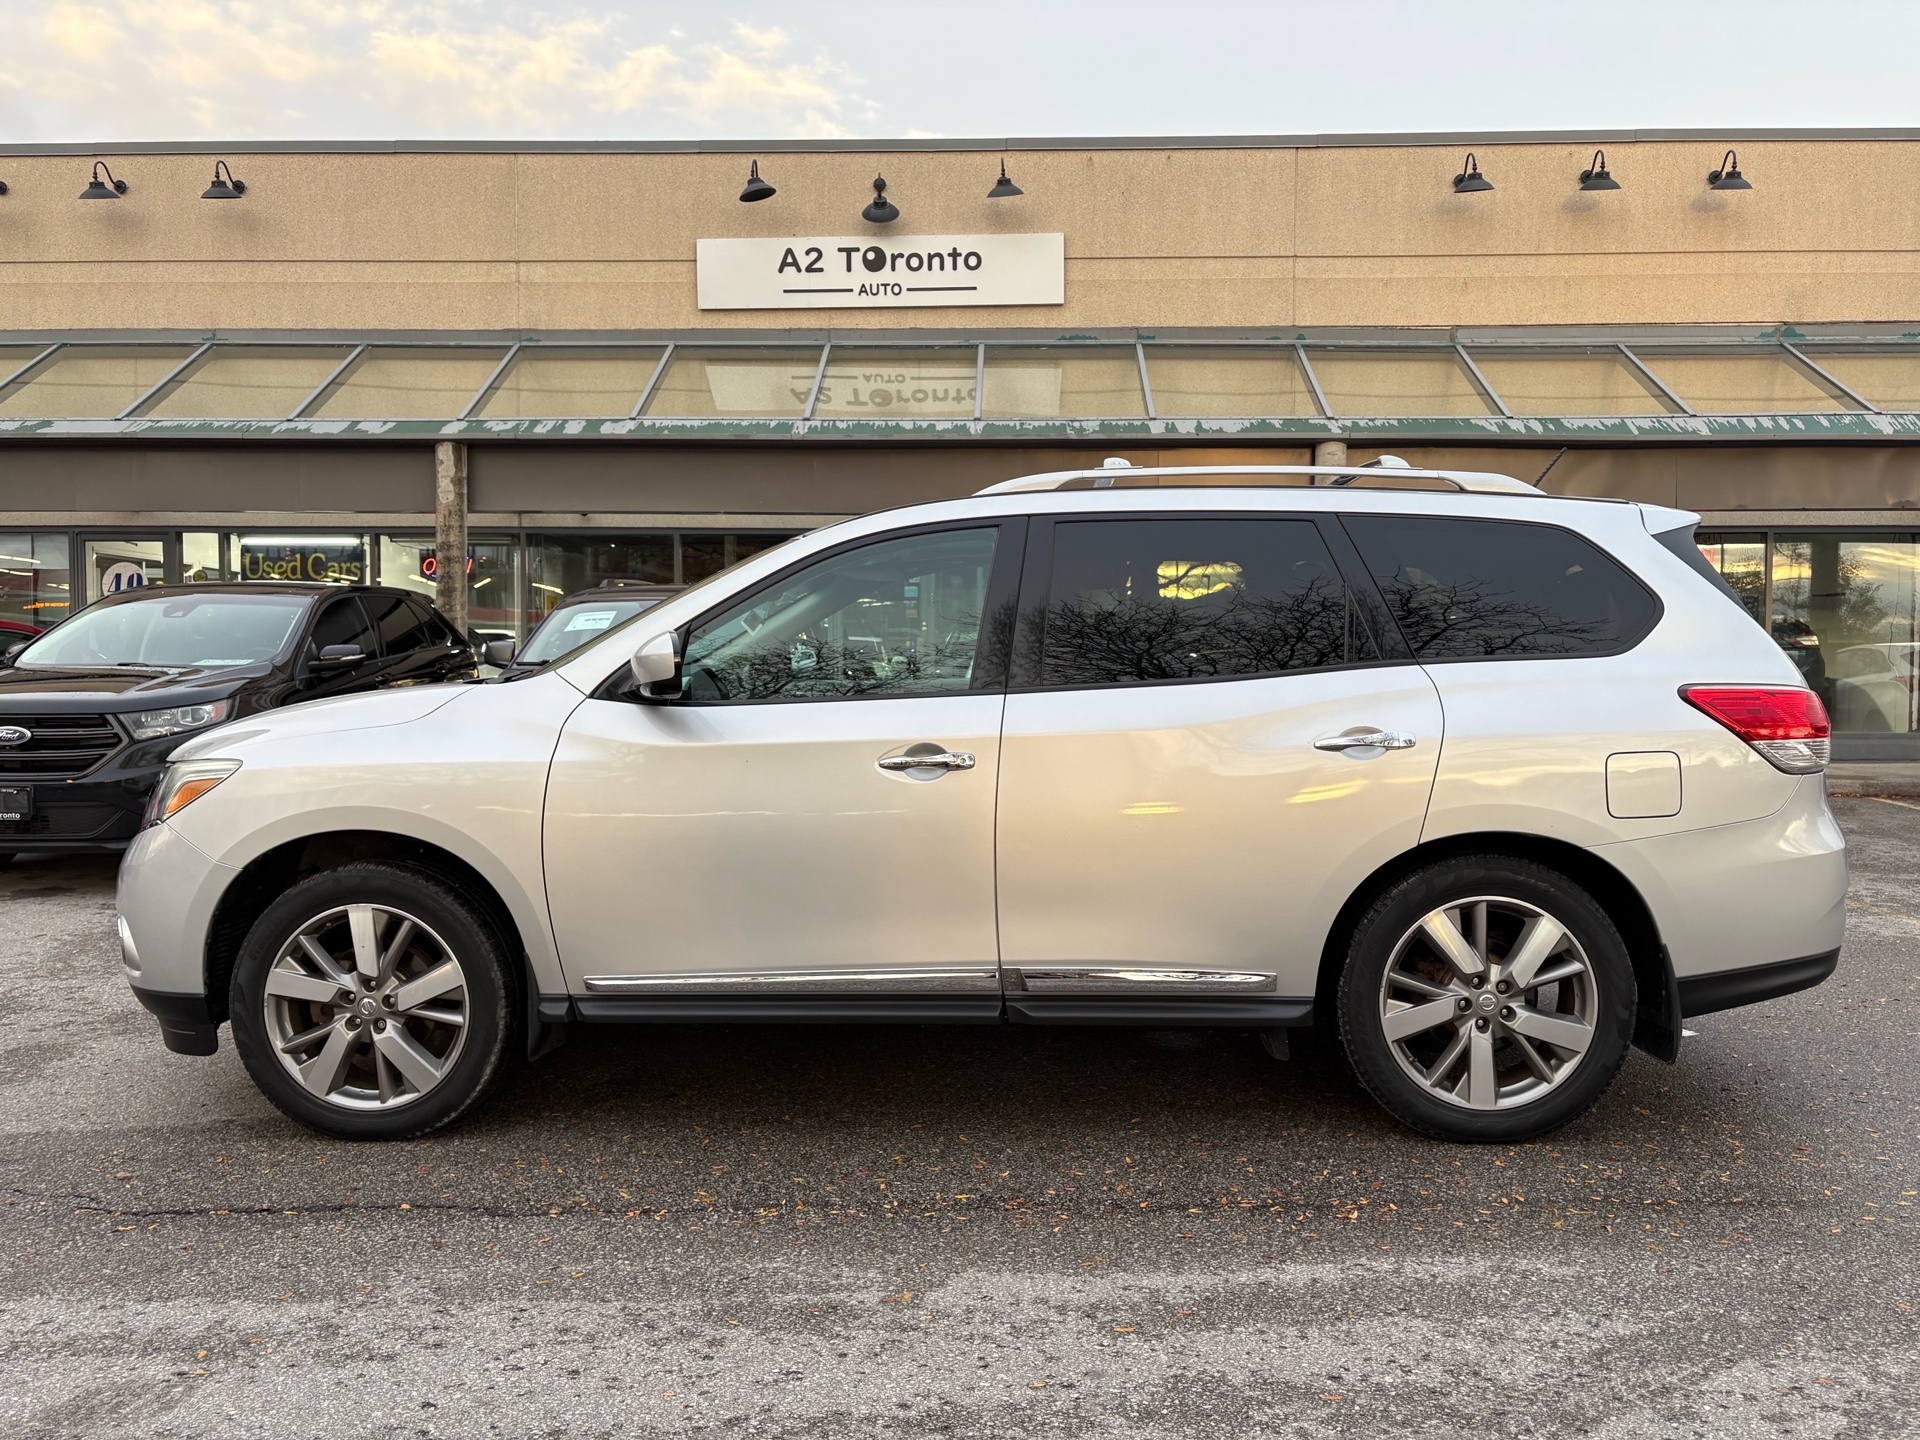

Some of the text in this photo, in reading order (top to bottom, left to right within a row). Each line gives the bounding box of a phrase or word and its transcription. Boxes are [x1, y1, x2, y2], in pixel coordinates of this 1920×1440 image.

[778, 247, 824, 273] A2
[858, 283, 902, 296] AUTO
[244, 553, 361, 579] Used Cars
